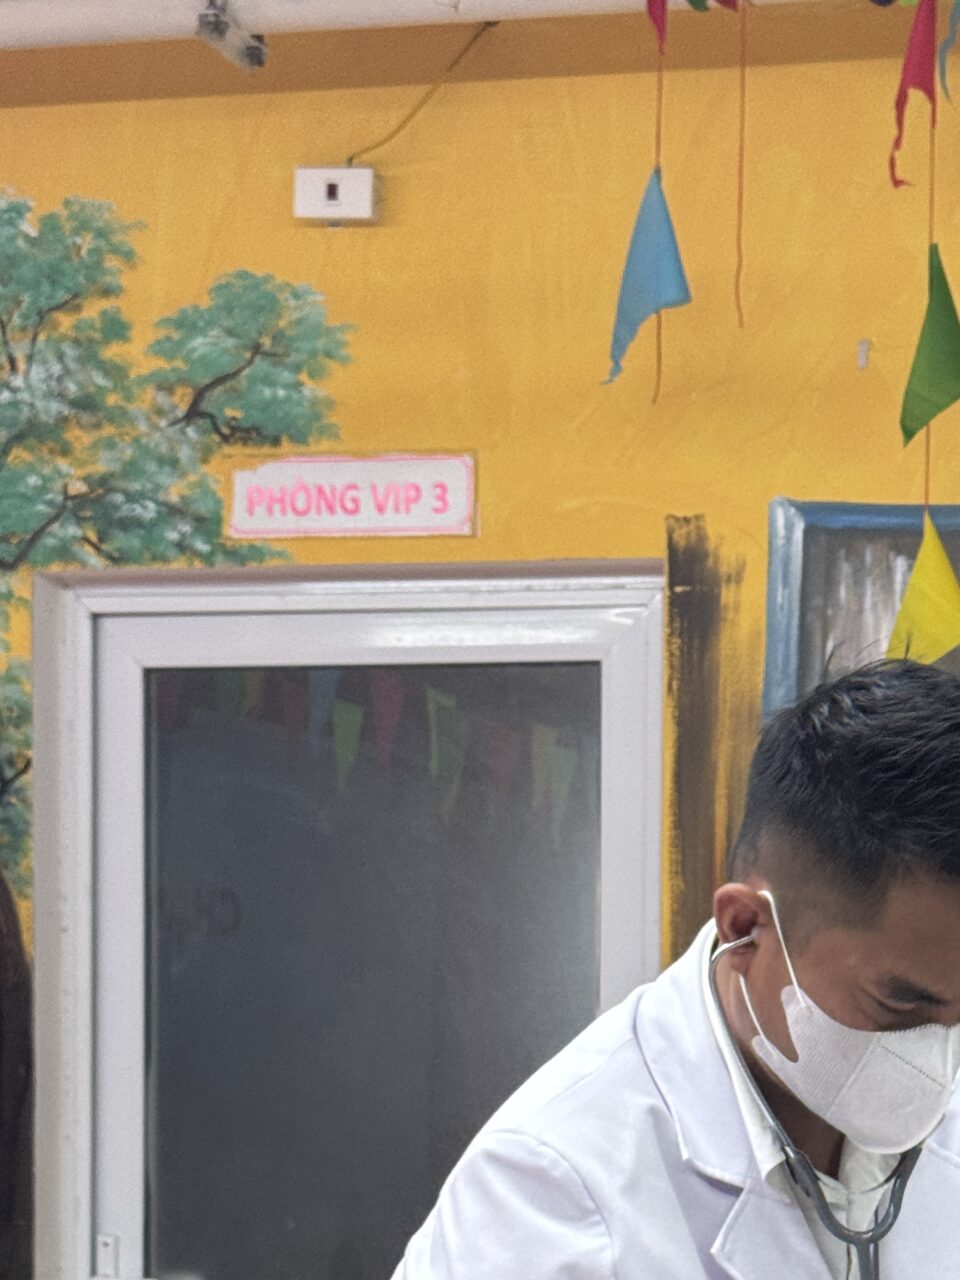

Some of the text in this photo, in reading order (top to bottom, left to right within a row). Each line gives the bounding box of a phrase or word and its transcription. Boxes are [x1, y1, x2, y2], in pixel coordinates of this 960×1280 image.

[246, 476, 449, 517] PHÒNG VIP 3
